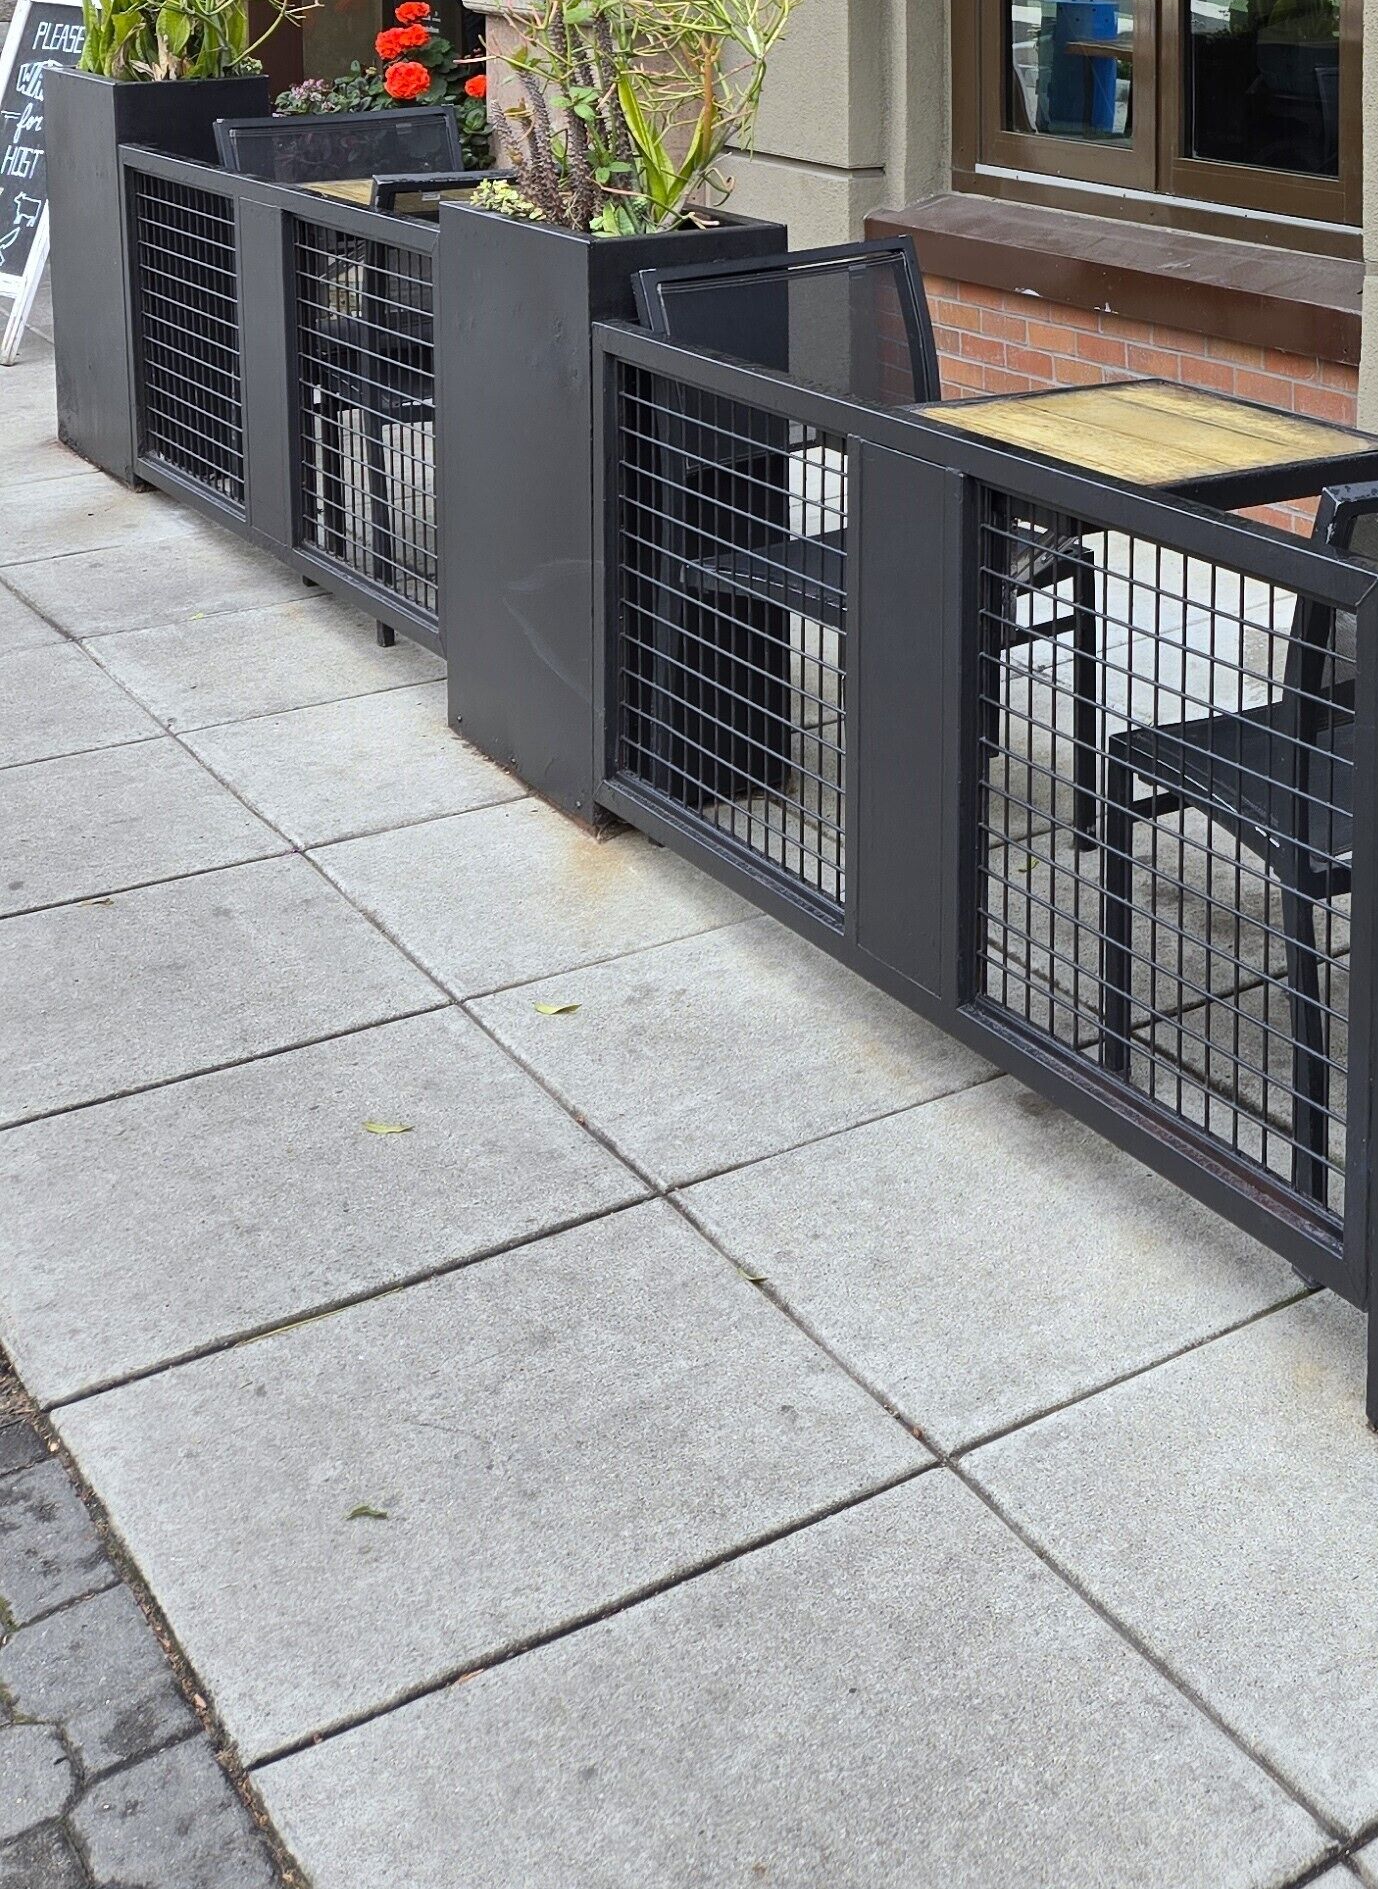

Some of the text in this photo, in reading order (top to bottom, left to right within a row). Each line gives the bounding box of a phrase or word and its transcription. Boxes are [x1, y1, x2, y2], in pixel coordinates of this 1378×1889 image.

[32, 21, 86, 54] PLEASE
[13, 102, 44, 144] for
[1, 144, 45, 180] HOST
